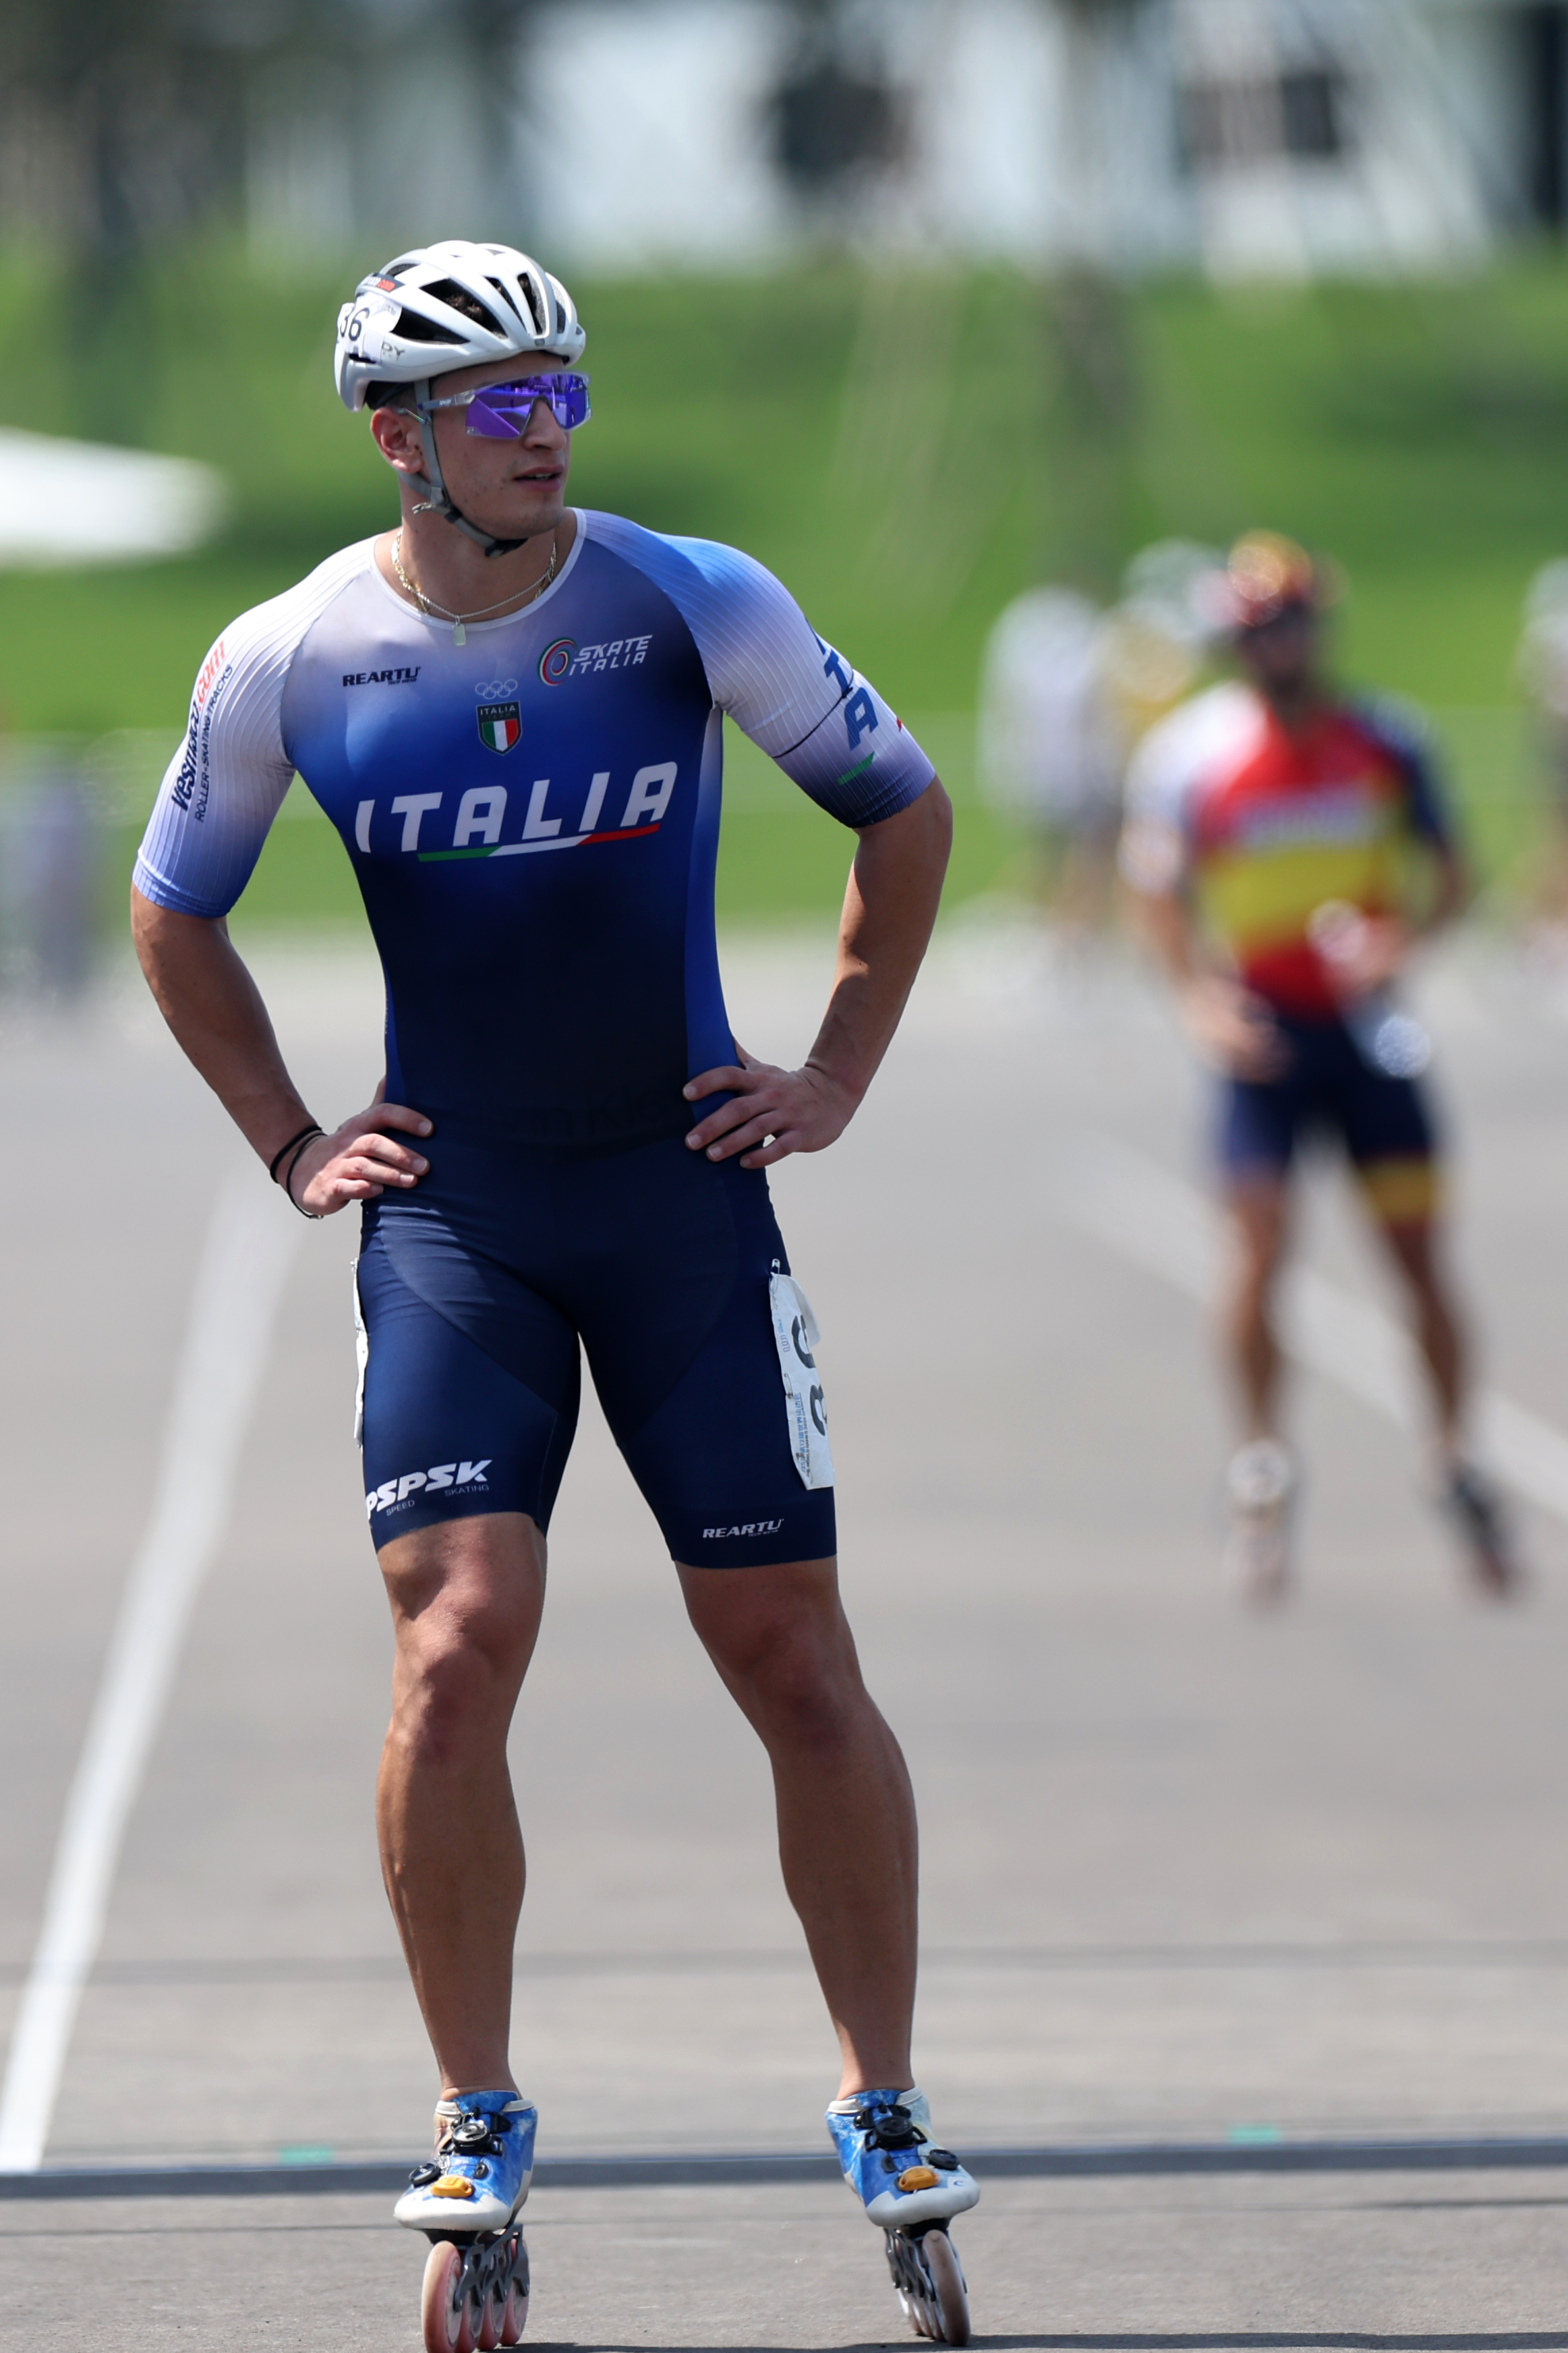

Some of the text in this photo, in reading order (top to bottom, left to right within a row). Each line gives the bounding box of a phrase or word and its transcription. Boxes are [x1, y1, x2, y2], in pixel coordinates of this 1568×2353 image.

[574, 634, 653, 662] SKATE
[569, 651, 646, 676] ITALIA
[207, 664, 233, 715] TRACKS
[480, 705, 516, 716] ITALIA
[354, 761, 678, 853] ITALIA
[386, 1484, 490, 1516] SPEED SKATING
